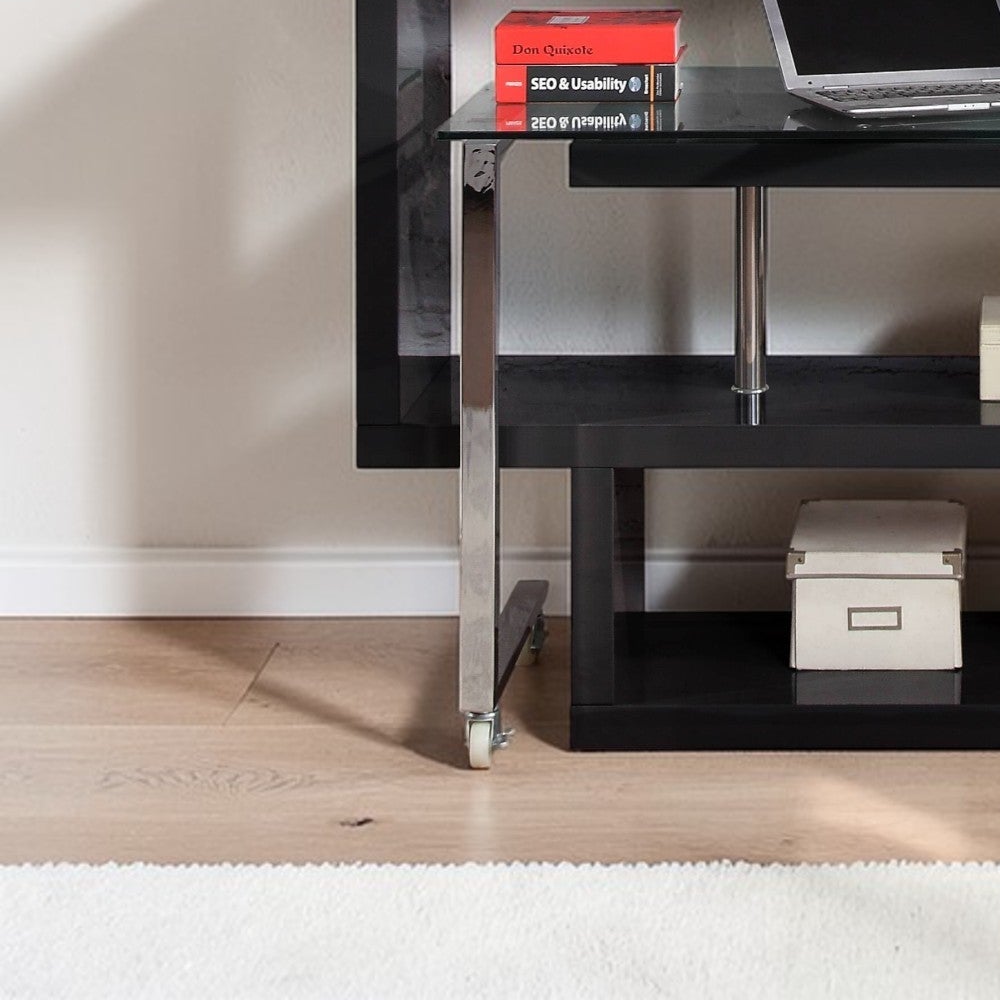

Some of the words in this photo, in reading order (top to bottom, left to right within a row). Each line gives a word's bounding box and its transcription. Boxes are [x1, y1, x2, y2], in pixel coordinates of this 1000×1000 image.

[512, 44, 540, 55] Don
[543, 44, 594, 57] Quixote
[530, 77, 558, 90] SEO
[558, 77, 570, 90] &
[571, 76, 627, 94] Usability
